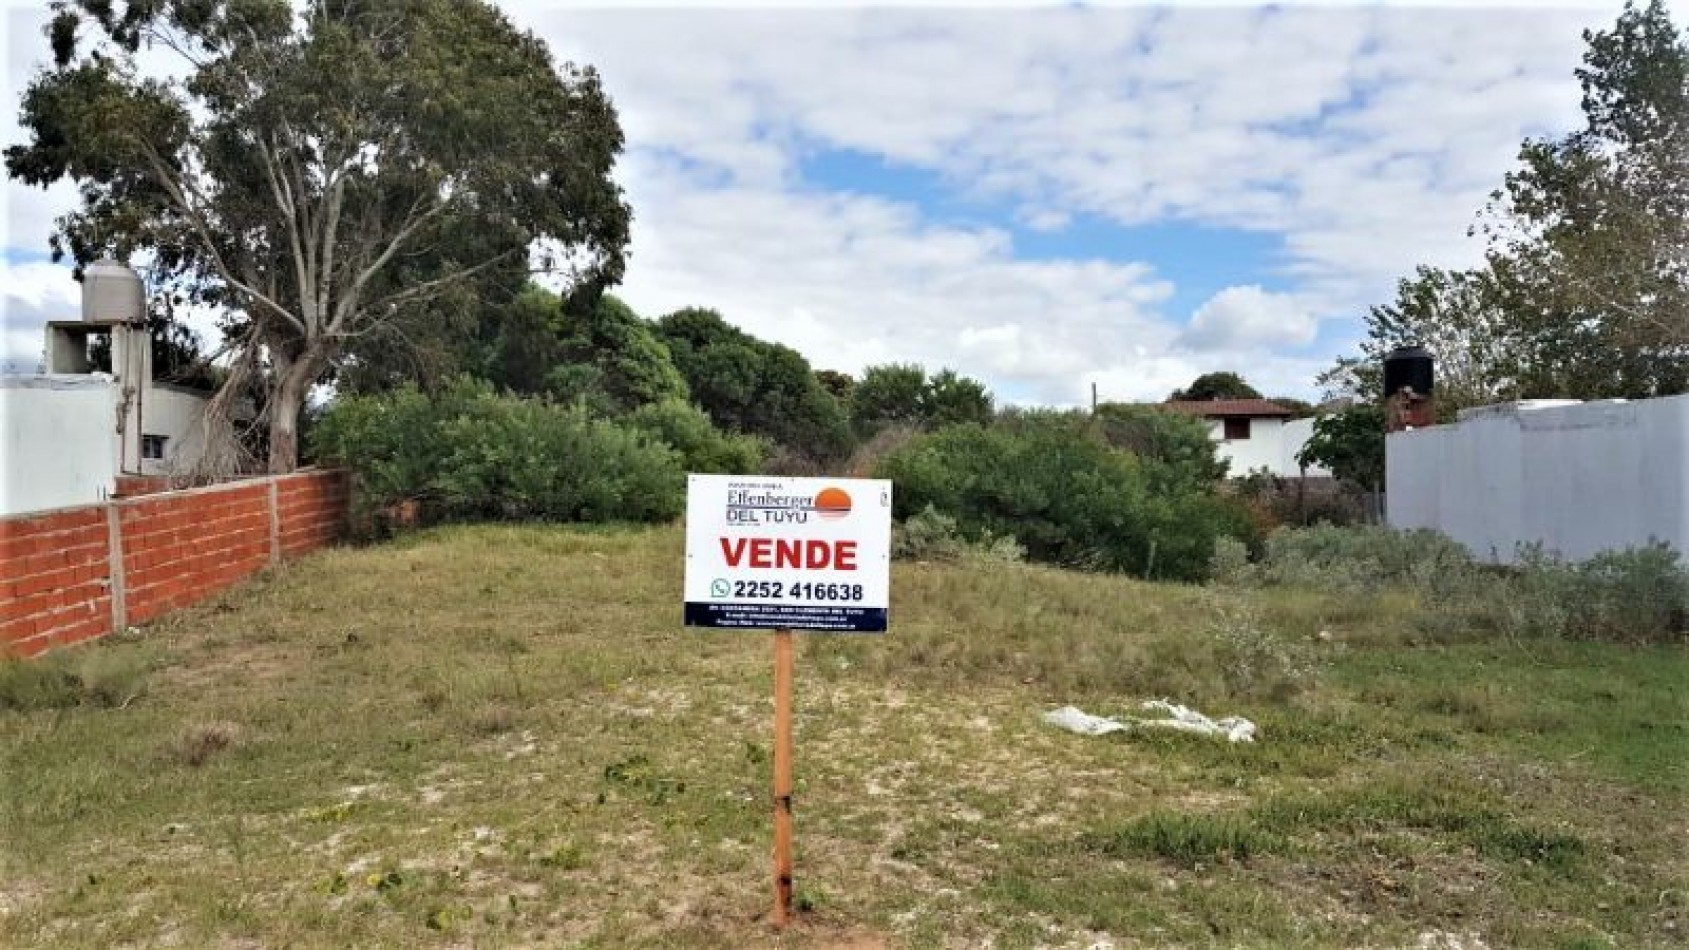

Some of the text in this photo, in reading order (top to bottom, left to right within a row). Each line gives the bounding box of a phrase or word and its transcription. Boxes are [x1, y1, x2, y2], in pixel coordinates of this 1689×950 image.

[727, 509, 807, 524] DEL TUYU
[720, 538, 858, 570] VENDE
[734, 580, 863, 601] 2252 416638
